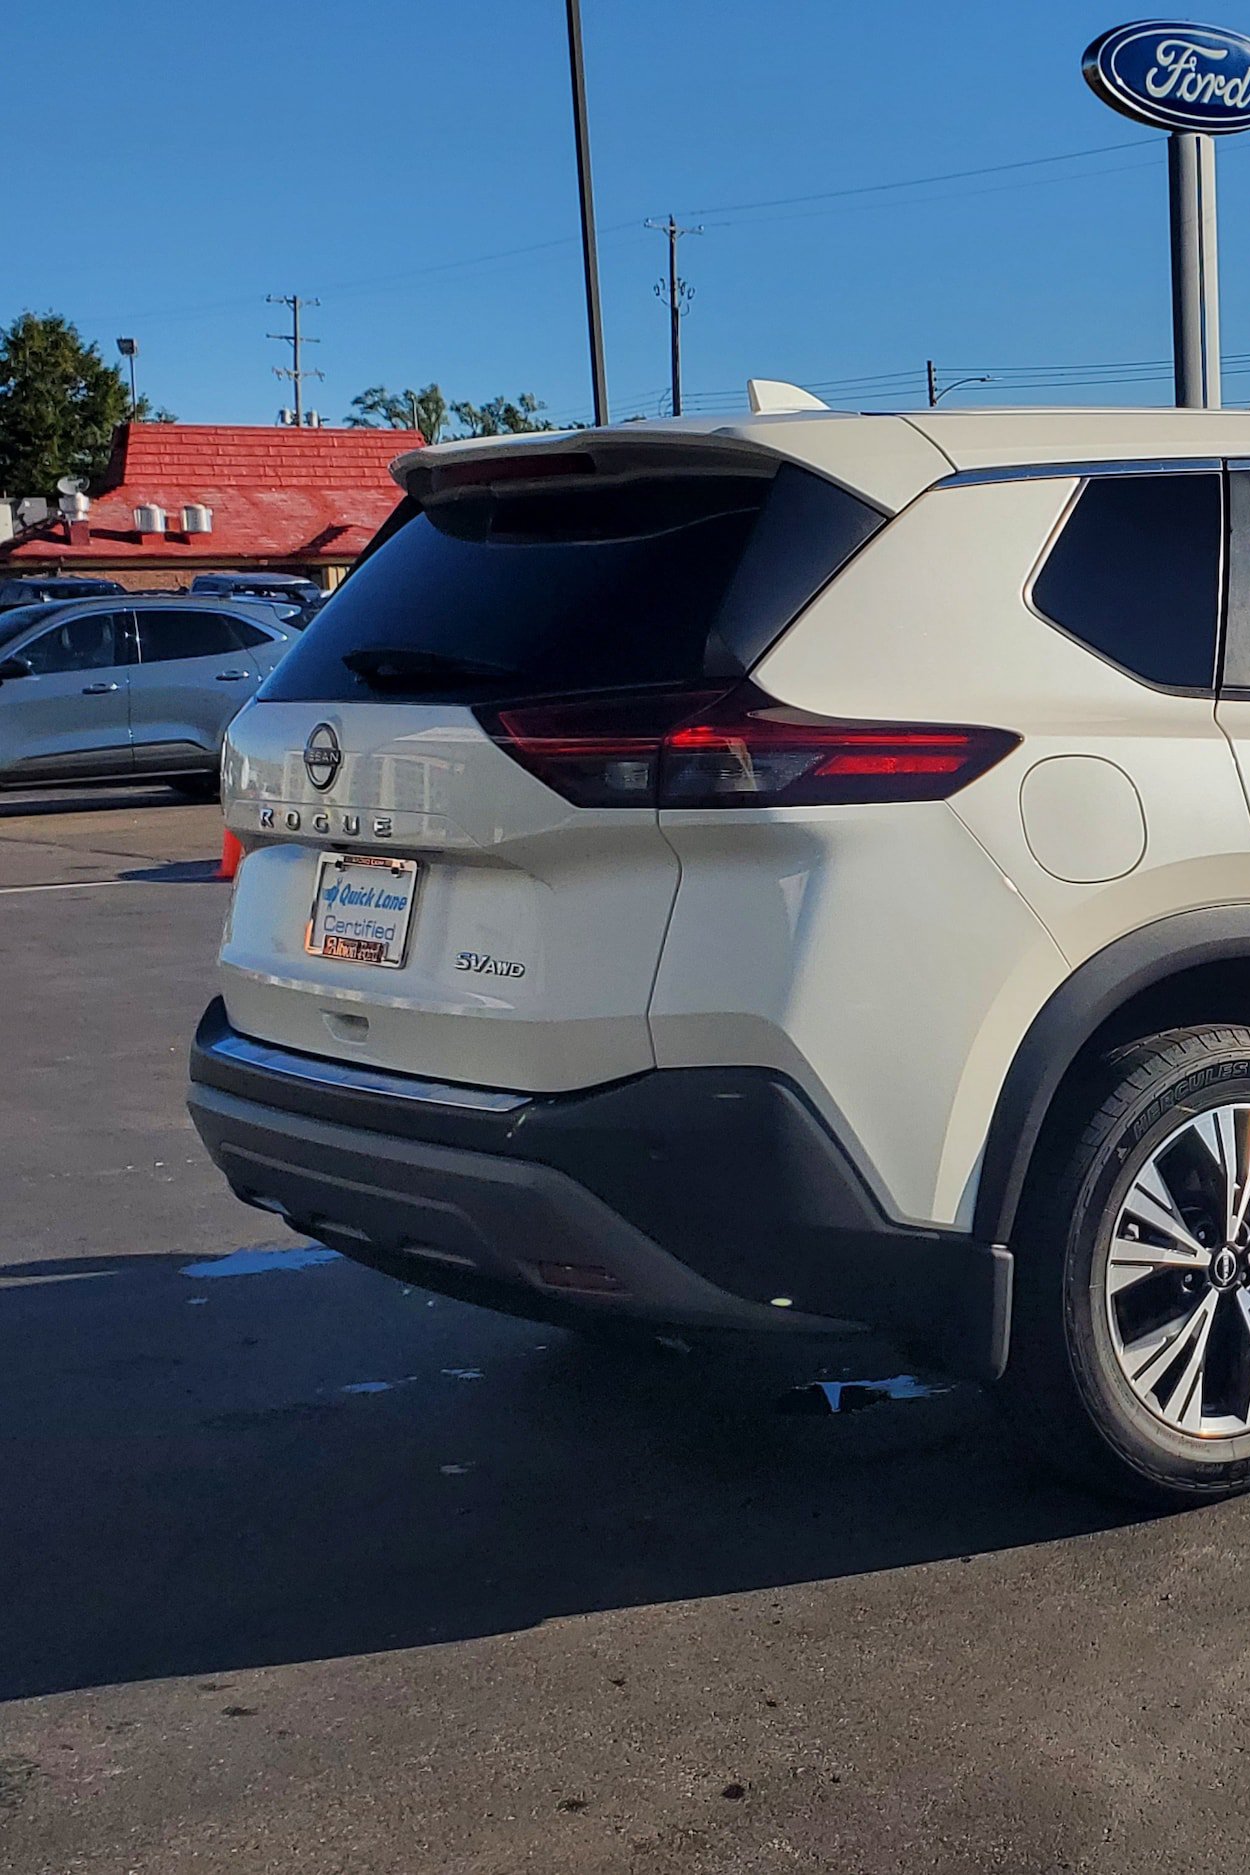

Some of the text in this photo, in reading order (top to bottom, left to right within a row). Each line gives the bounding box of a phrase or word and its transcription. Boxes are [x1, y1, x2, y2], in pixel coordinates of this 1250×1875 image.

[260, 808, 392, 838] ROGUE
[340, 883, 408, 911] Quick Lane
[323, 914, 397, 941] Certified
[1132, 1061, 1249, 1141] HERCULES
